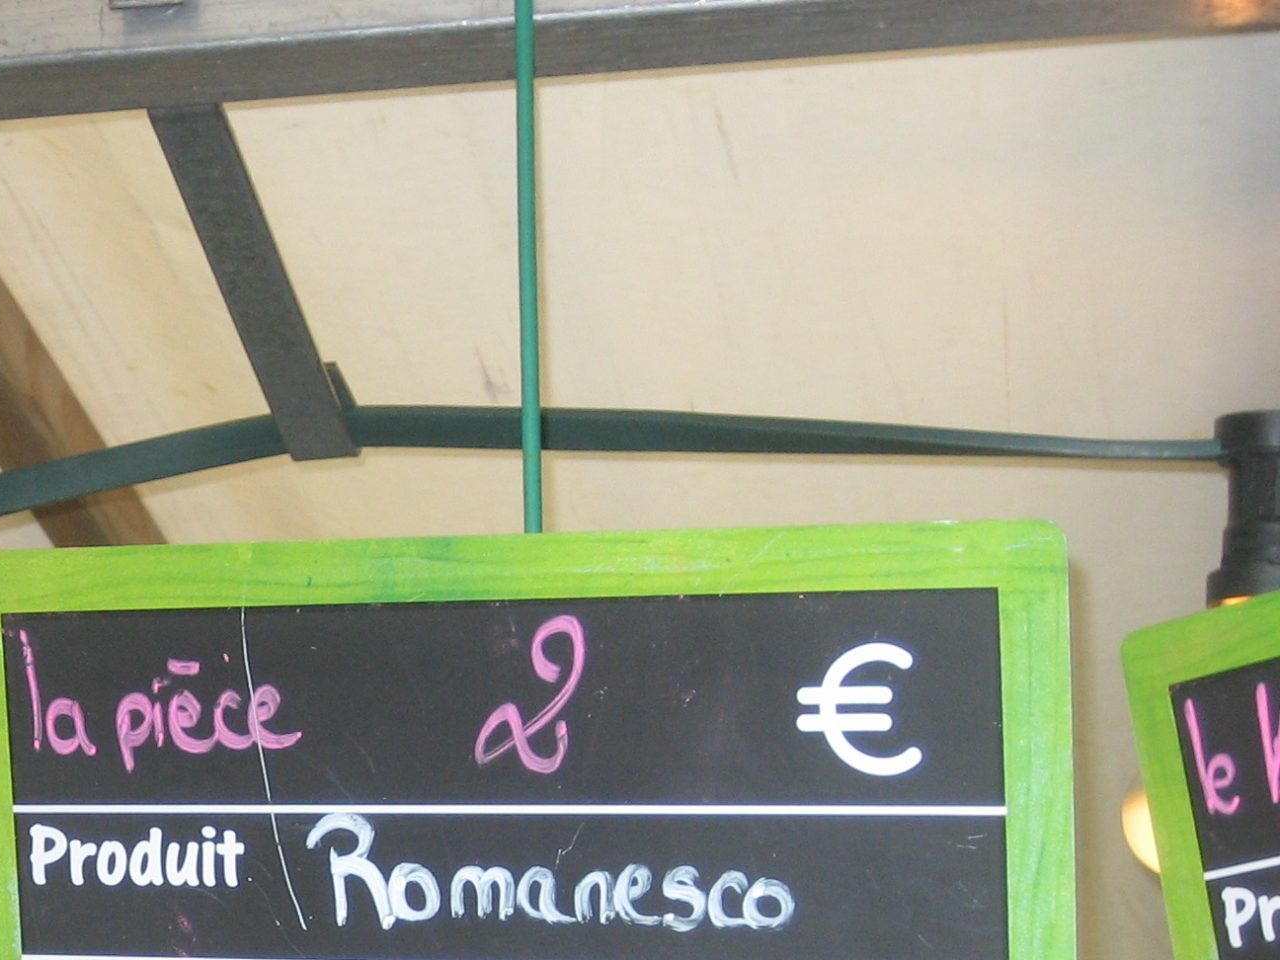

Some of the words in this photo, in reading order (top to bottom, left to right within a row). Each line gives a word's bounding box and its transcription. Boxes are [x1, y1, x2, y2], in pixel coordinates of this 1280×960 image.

[19, 629, 97, 756] la
[475, 614, 585, 774] 2
[796, 642, 922, 776] €
[1184, 697, 1240, 815] le
[29, 822, 245, 888] Produit
[306, 812, 795, 932] Romanesco
